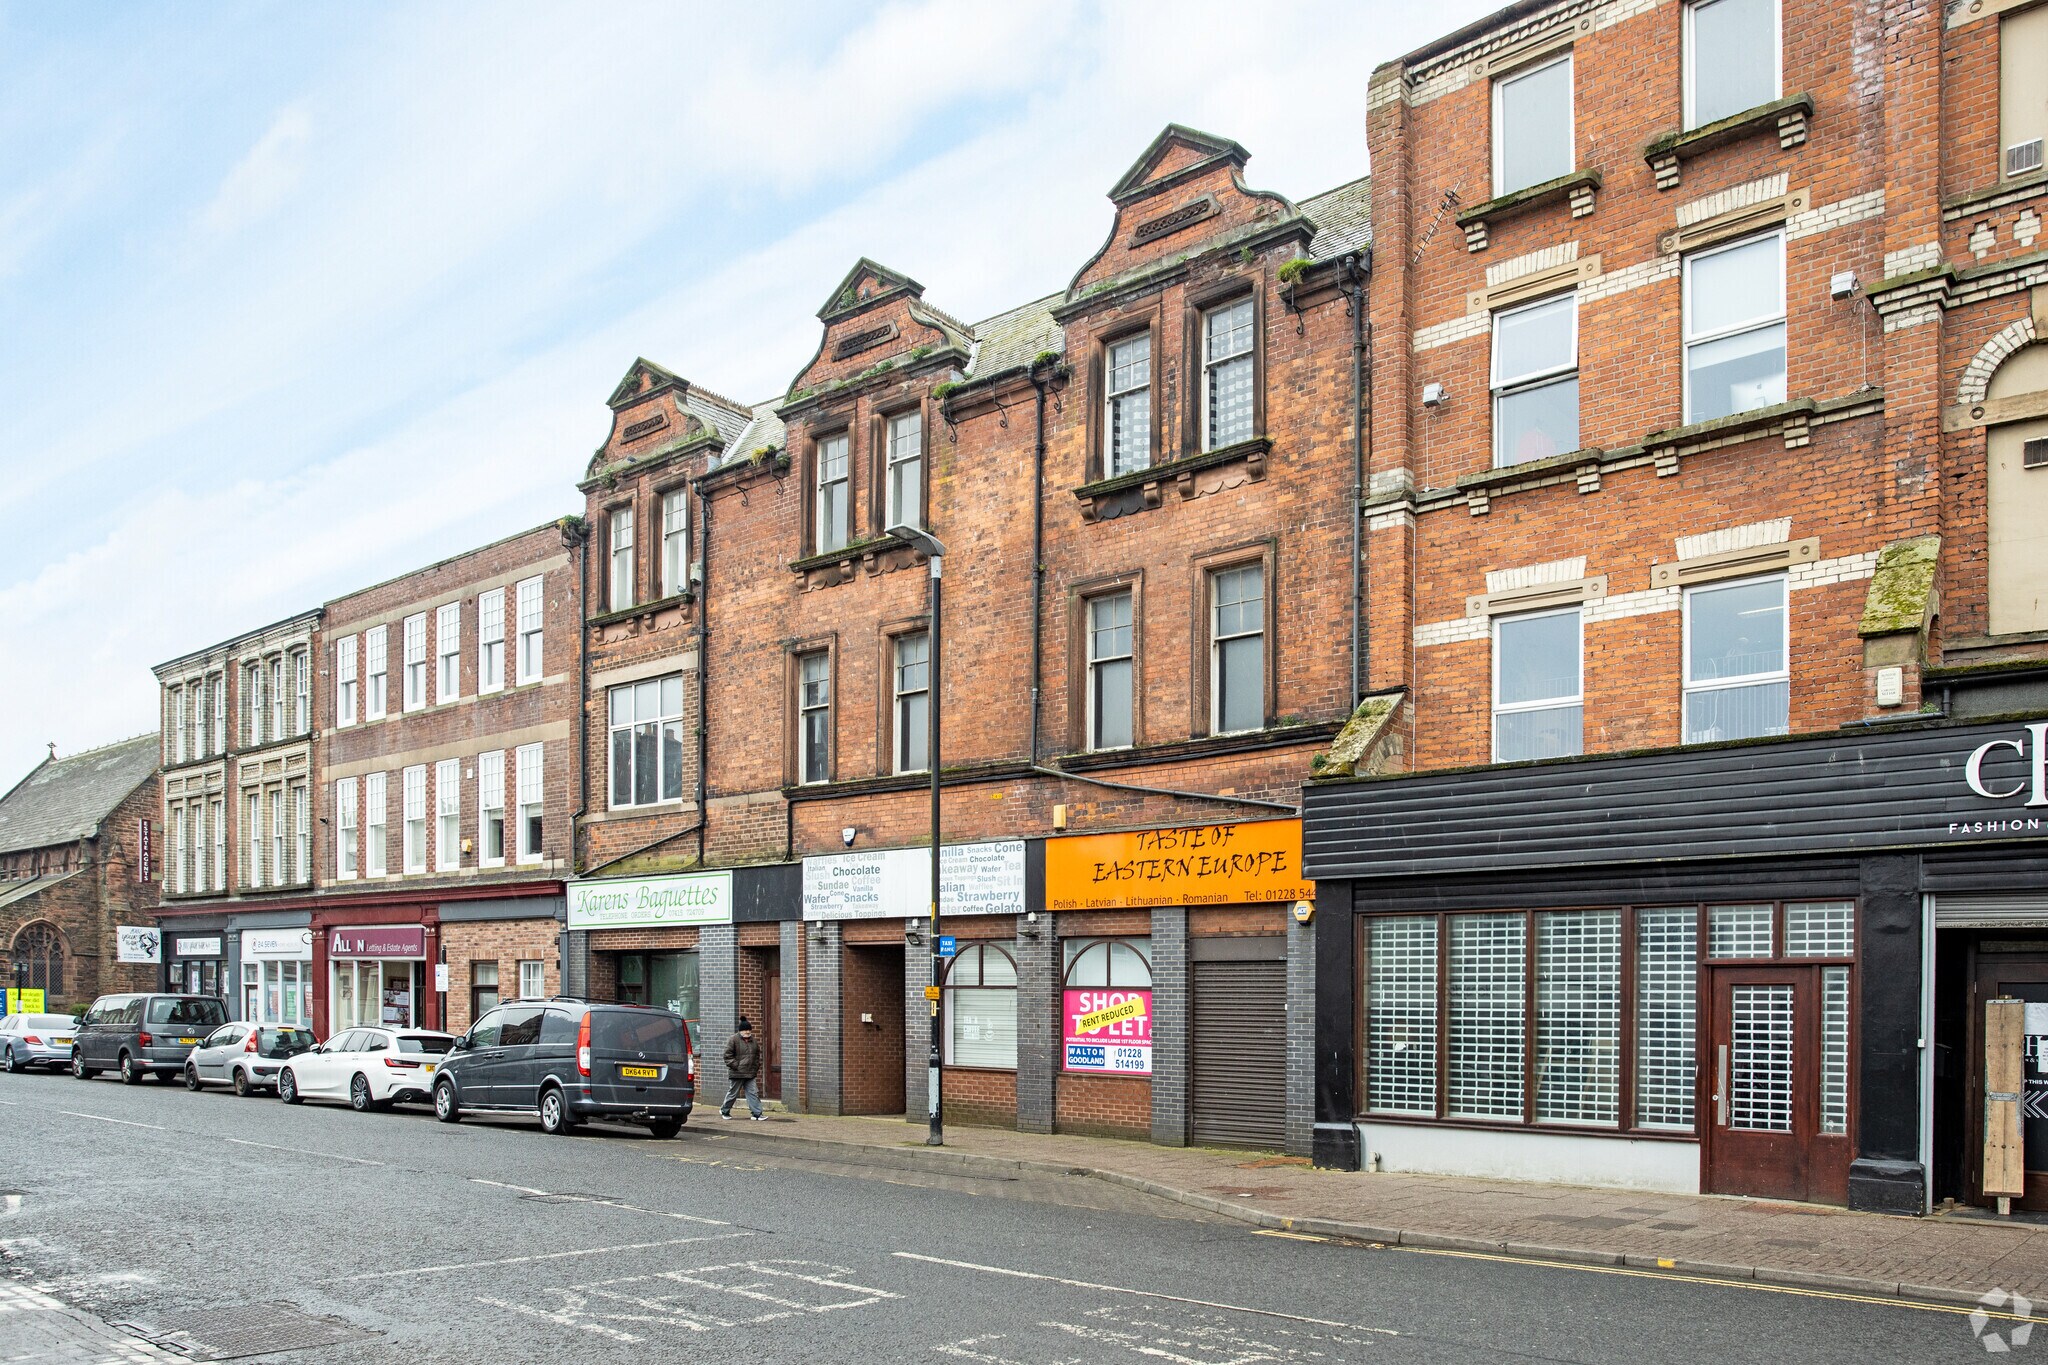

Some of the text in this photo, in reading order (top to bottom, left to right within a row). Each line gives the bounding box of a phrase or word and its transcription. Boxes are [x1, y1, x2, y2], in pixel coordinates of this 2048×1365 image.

[1949, 818, 2039, 834] FASHION
[1137, 825, 1236, 850] TASTE OF
[967, 842, 1022, 854] Snacks Cone
[843, 852, 886, 863] Ice Cream
[969, 854, 1005, 863] Chocolate
[832, 865, 880, 877] Chocolate
[940, 863, 978, 874] keaway
[981, 860, 1021, 873] Wafer Tea
[1093, 851, 1287, 884] EASTERN EUROPE
[805, 870, 830, 881] Slush
[851, 875, 881, 885] Coffee
[977, 875, 996, 883] Slush
[817, 880, 849, 891] Sundae
[940, 882, 965, 892] alian
[804, 893, 830, 904] Wafer
[844, 892, 879, 903] Snacks
[957, 890, 1020, 902] Strawberry
[1244, 891, 1262, 901] Tel:
[1266, 889, 1296, 900] 01228
[577, 885, 719, 919] Karens Baguettes
[1053, 893, 1228, 909] Polish Latvian Lithuanian Romanian
[810, 903, 843, 911] Strawberry
[962, 903, 1022, 914] Coffee Gelato
[821, 909, 887, 919] Delicious Toppings
[366, 944, 381, 953] Letting
[387, 944, 401, 952] Estate
[401, 944, 418, 954] Agents
[1082, 1005, 1134, 1028] RENT REDUCED
[1108, 1016, 1148, 1036] LET
[1069, 1048, 1104, 1056] WALTON
[1118, 1048, 1142, 1058] 01228
[1069, 1056, 1105, 1065] GOODLAND
[1115, 1059, 1145, 1070] 514199
